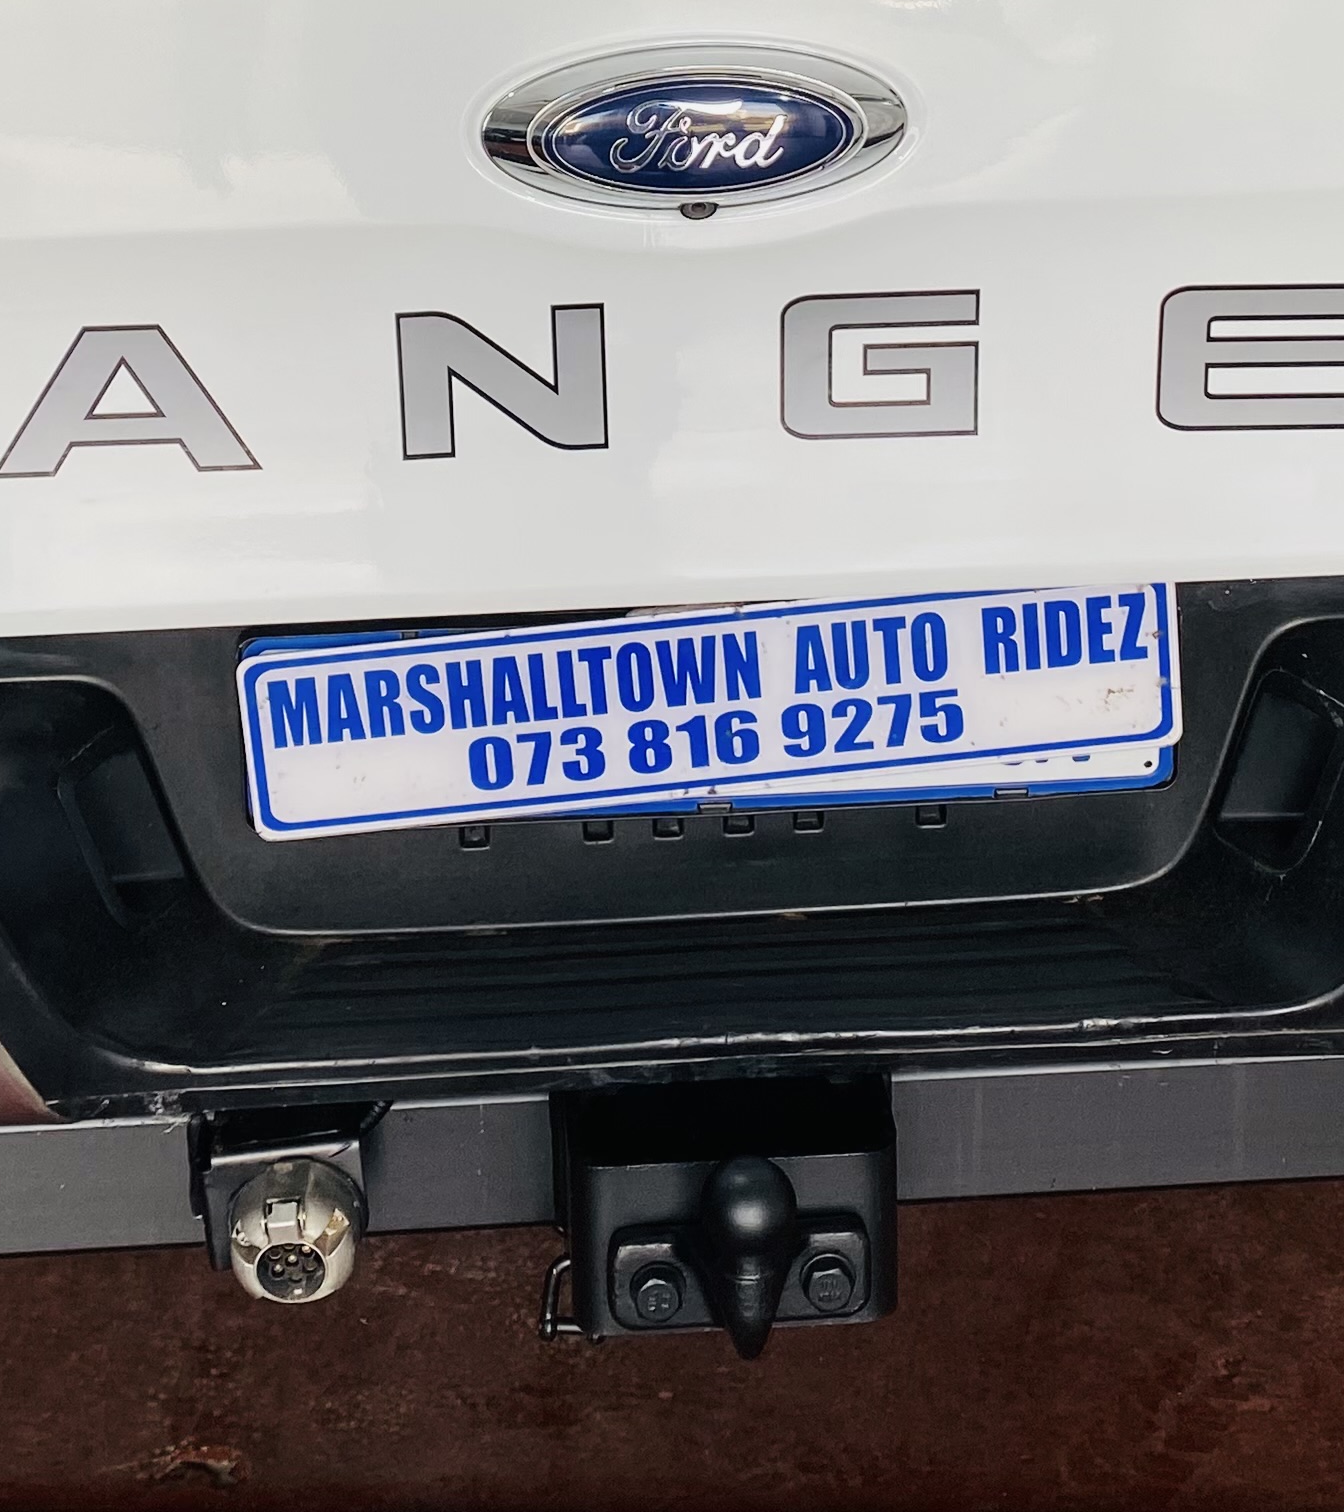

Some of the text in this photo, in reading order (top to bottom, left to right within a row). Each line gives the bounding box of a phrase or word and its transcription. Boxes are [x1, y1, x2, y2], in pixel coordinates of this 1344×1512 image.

[609, 99, 788, 174] Ford
[267, 592, 1148, 749] MARSHALLTOWN AUTO RIDEZ
[468, 689, 964, 791] 073 816 9275
